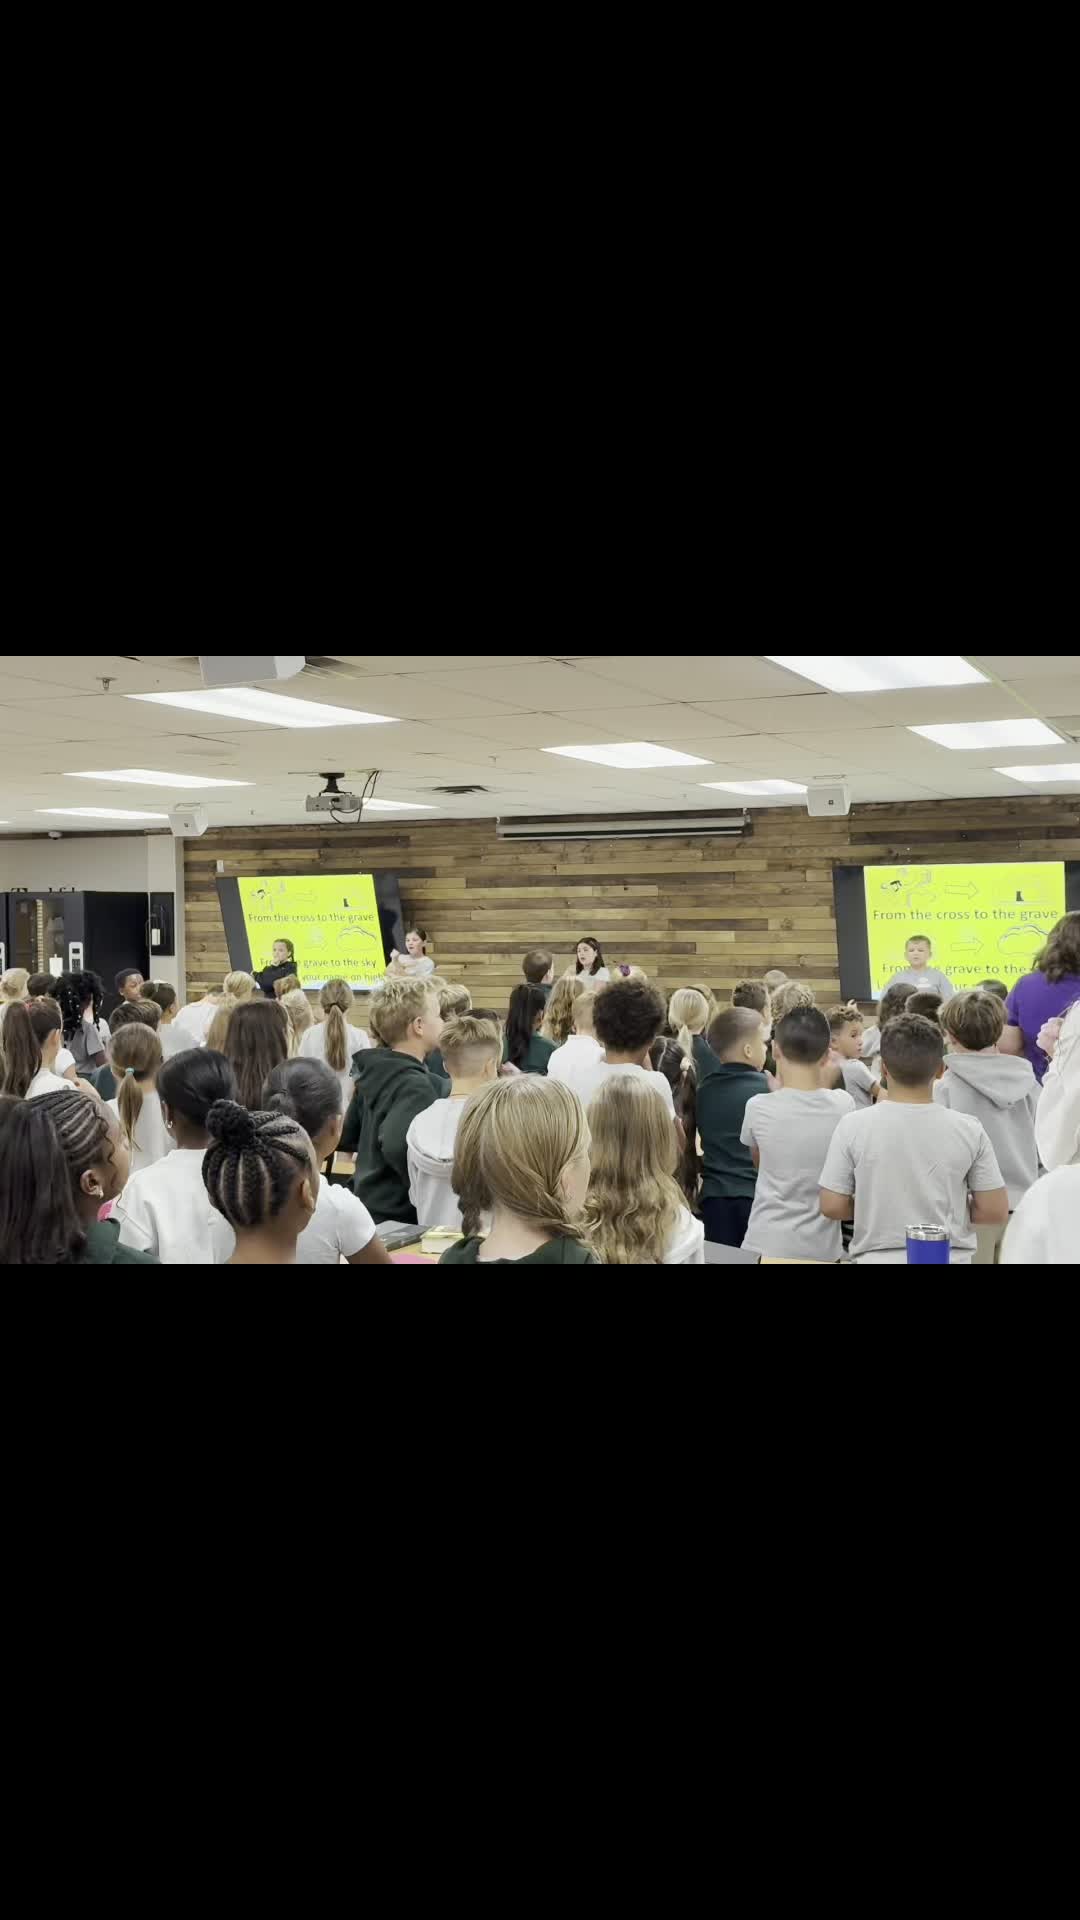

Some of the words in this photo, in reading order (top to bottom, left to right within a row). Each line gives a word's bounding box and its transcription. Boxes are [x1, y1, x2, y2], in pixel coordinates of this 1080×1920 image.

[248, 913, 272, 922] From
[274, 912, 289, 922] the
[292, 914, 315, 922] cross
[317, 913, 327, 921] to
[329, 912, 346, 921] the
[348, 914, 375, 924] grave
[873, 910, 906, 920] From
[911, 909, 932, 920] the
[936, 911, 970, 920] cross
[974, 909, 989, 920] to
[993, 908, 1016, 920] the
[1020, 910, 1058, 921] grave
[303, 959, 328, 969] grave
[331, 958, 341, 967] to
[343, 957, 359, 967] the
[361, 957, 377, 969] sky
[945, 965, 981, 976] grave
[986, 964, 1000, 974] to
[1004, 963, 1026, 974] the
[302, 974, 321, 983] your
